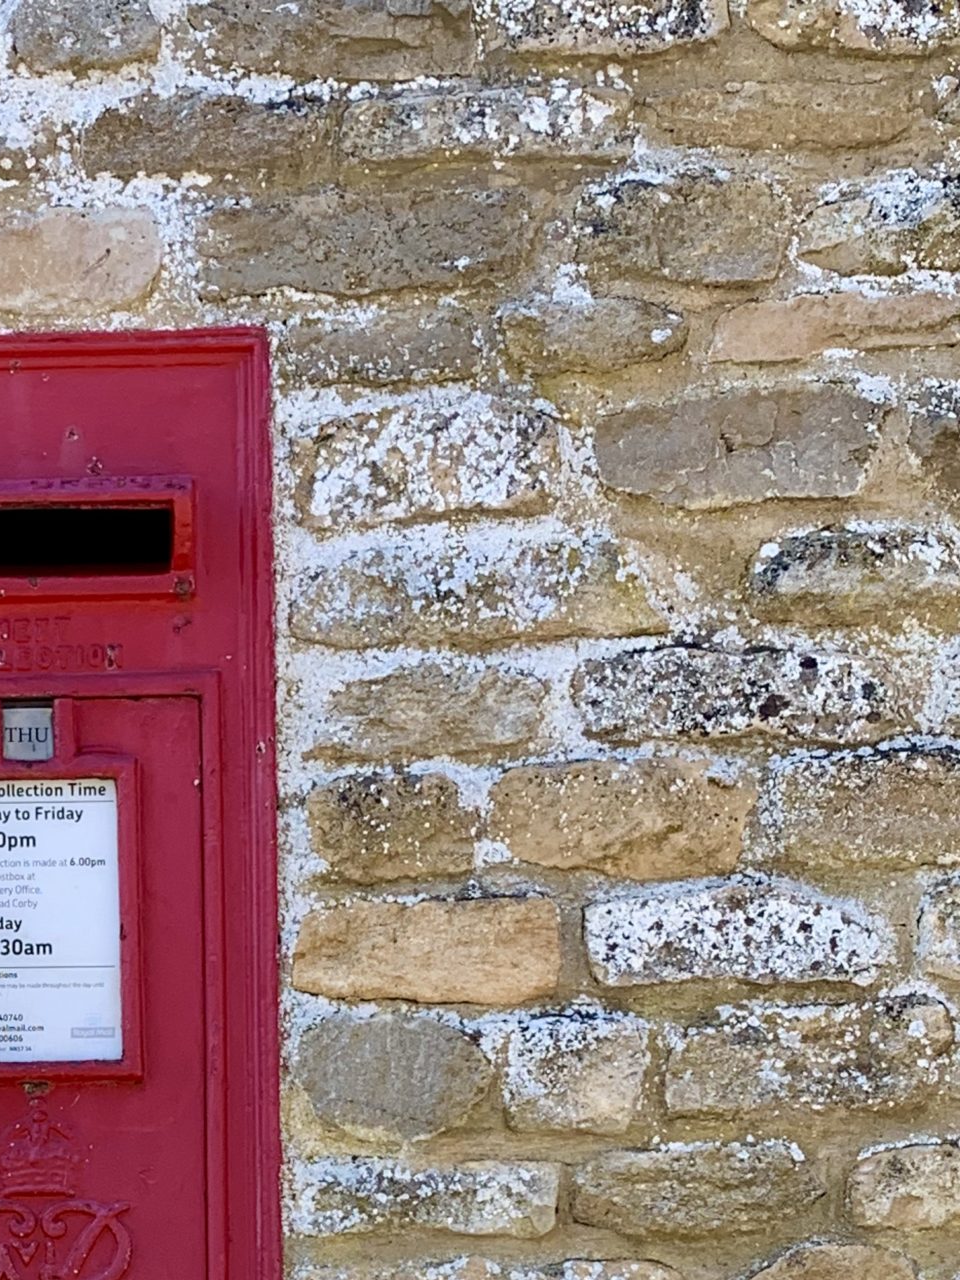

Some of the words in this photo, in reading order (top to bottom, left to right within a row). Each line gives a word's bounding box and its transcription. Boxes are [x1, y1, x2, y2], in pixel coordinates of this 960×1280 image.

[5, 727, 49, 743] THU
[67, 782, 107, 796] Time
[15, 809, 30, 820] to
[35, 806, 83, 822] Friday
[23, 858, 30, 867] is
[32, 858, 57, 867] made
[58, 858, 68, 867] at
[69, 857, 106, 869] 6.00pm
[27, 872, 36, 881] at
[12, 899, 38, 910] Corby
